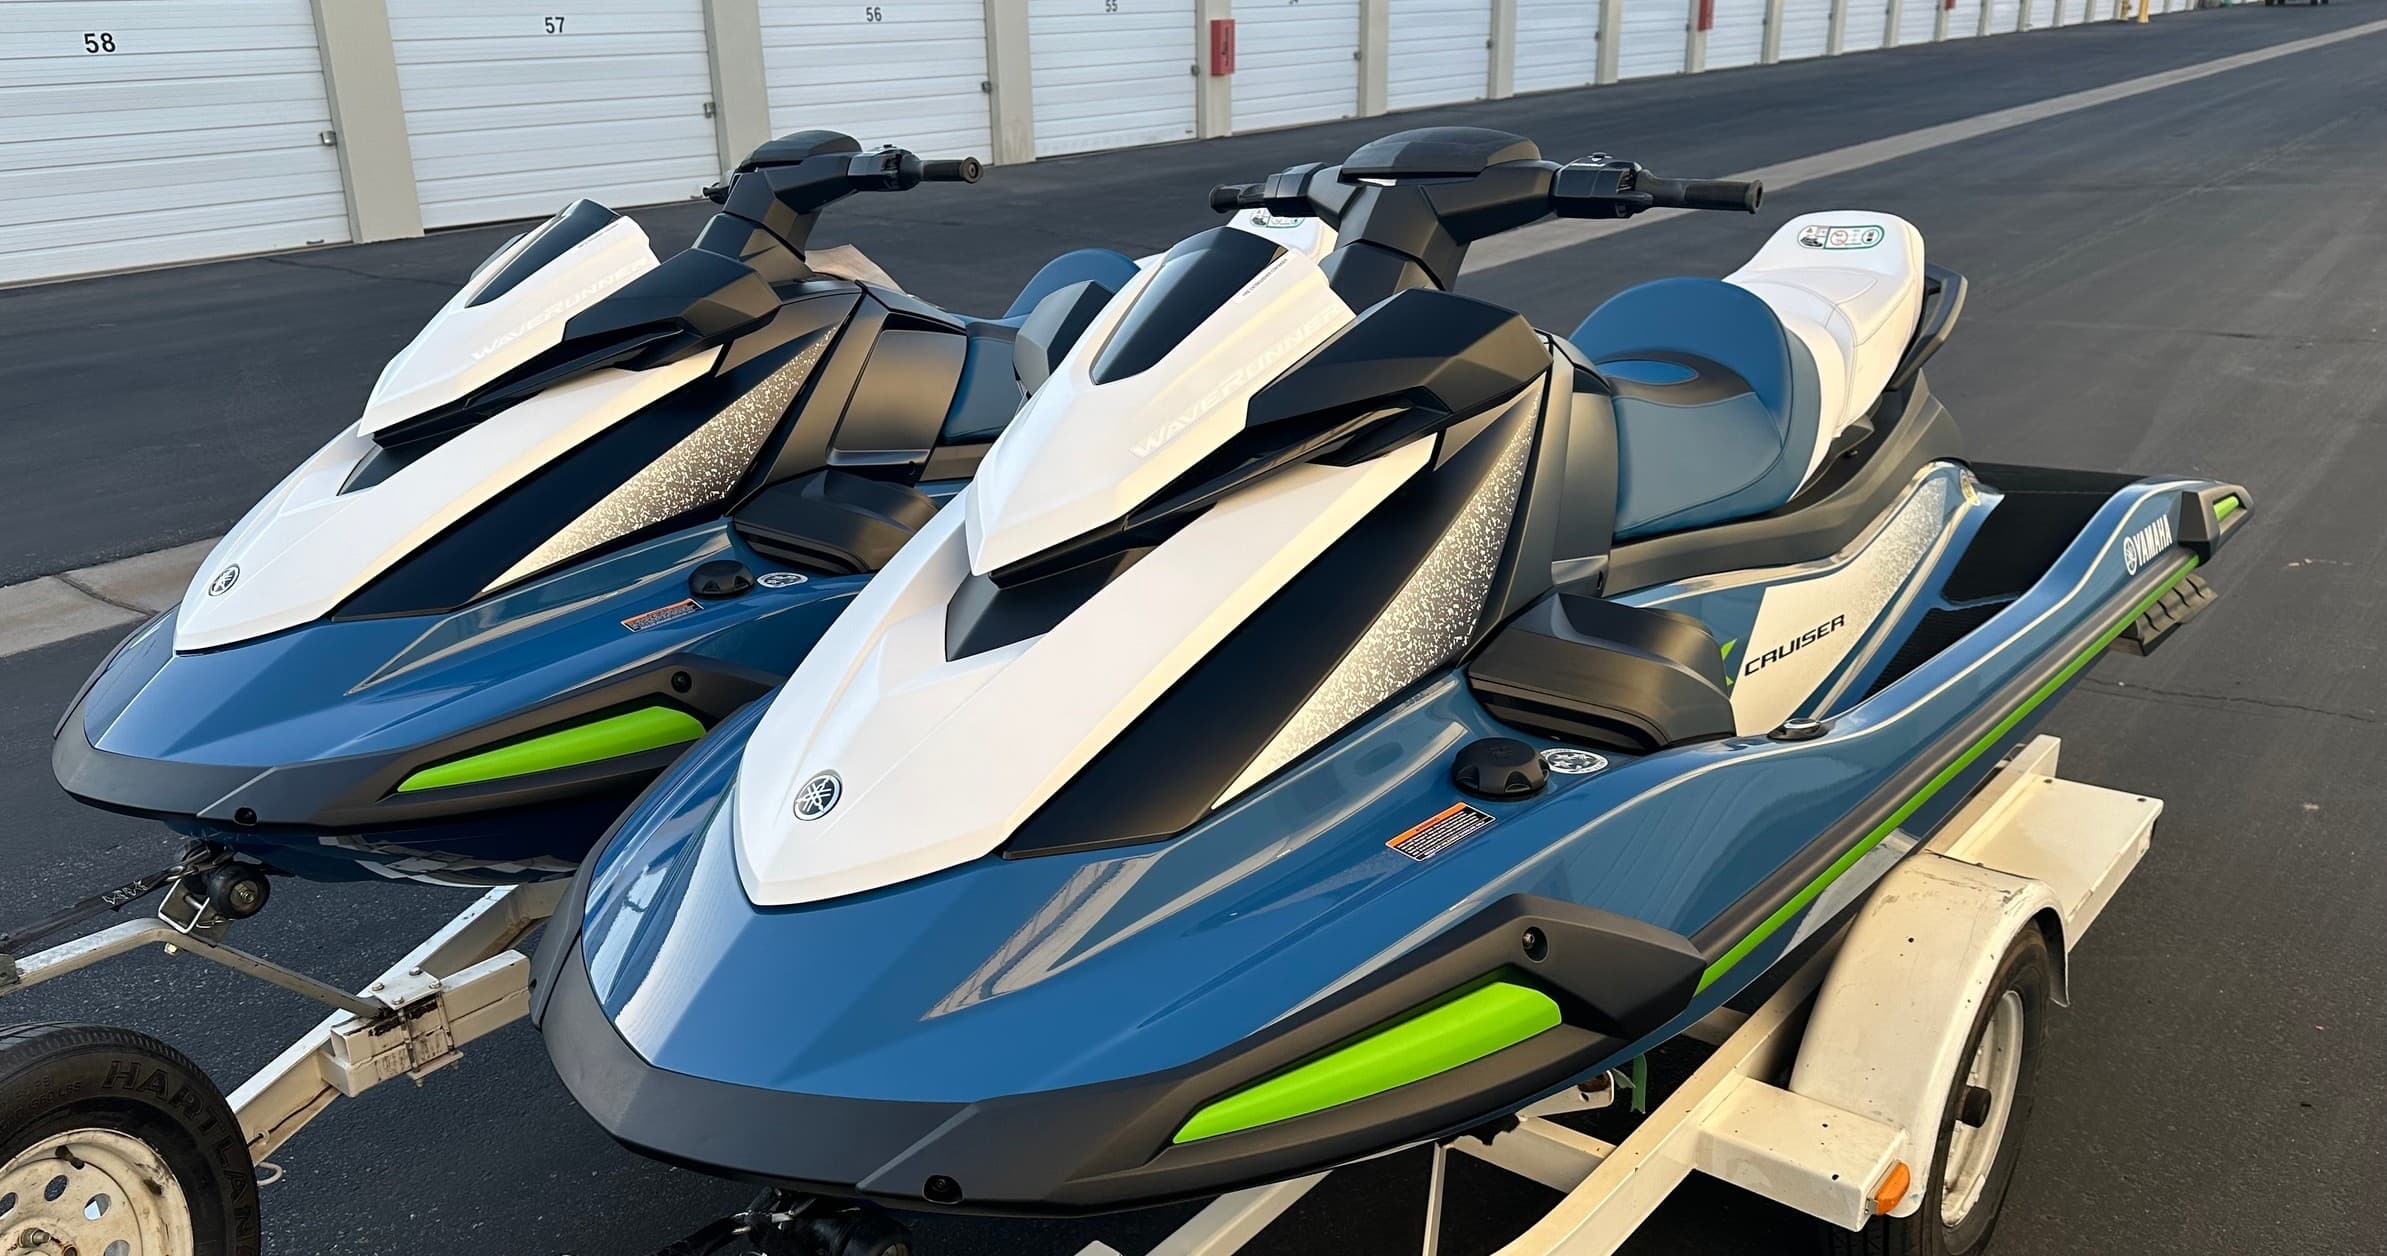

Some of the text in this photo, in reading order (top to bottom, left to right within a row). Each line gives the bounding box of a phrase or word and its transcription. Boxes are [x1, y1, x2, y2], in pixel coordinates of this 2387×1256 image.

[866, 7, 882, 22] 56
[1105, 0, 1118, 13] 55
[545, 16, 565, 34] 57
[84, 32, 116, 53] 58
[2132, 513, 2173, 567] YAMAHA
[1744, 613, 1846, 676] CRUISER
